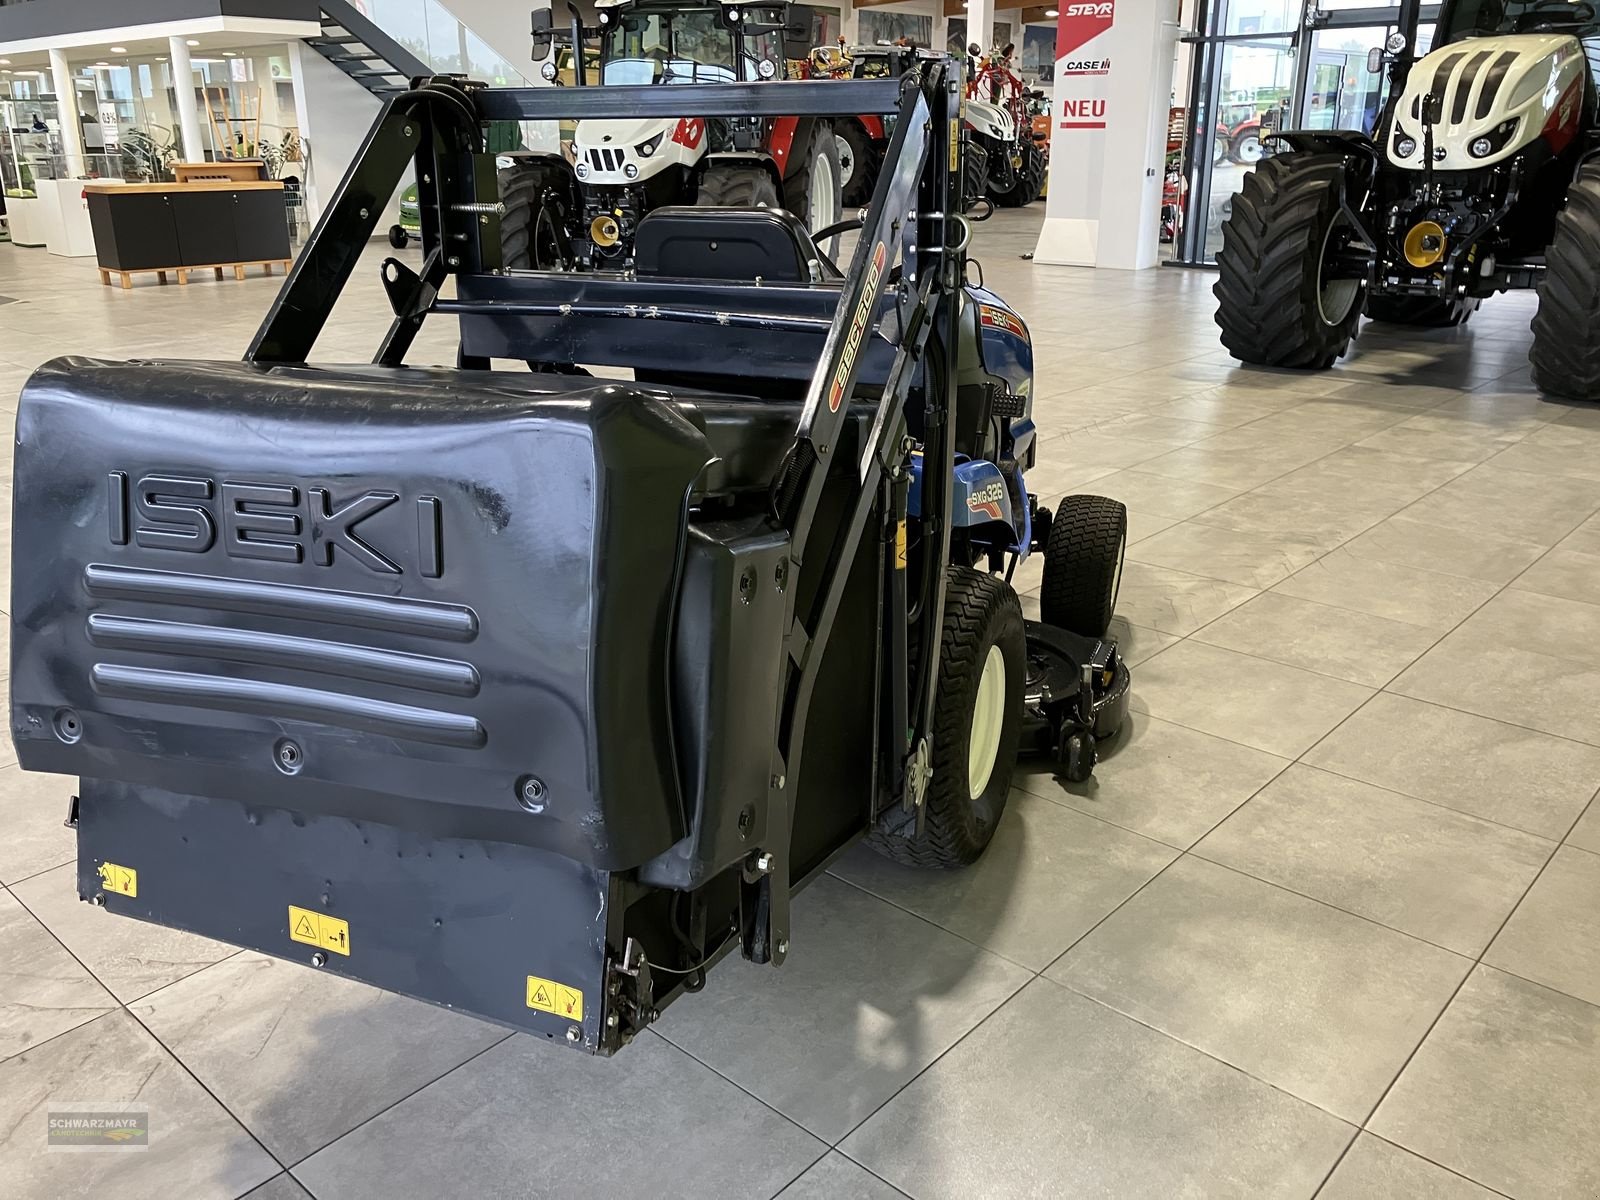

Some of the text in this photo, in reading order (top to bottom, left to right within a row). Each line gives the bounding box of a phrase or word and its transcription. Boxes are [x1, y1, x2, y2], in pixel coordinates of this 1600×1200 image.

[1066, 2, 1113, 16] STEYR
[1066, 61, 1099, 70] CASE
[1064, 100, 1106, 117] NEU
[107, 470, 444, 579] ISEKI
